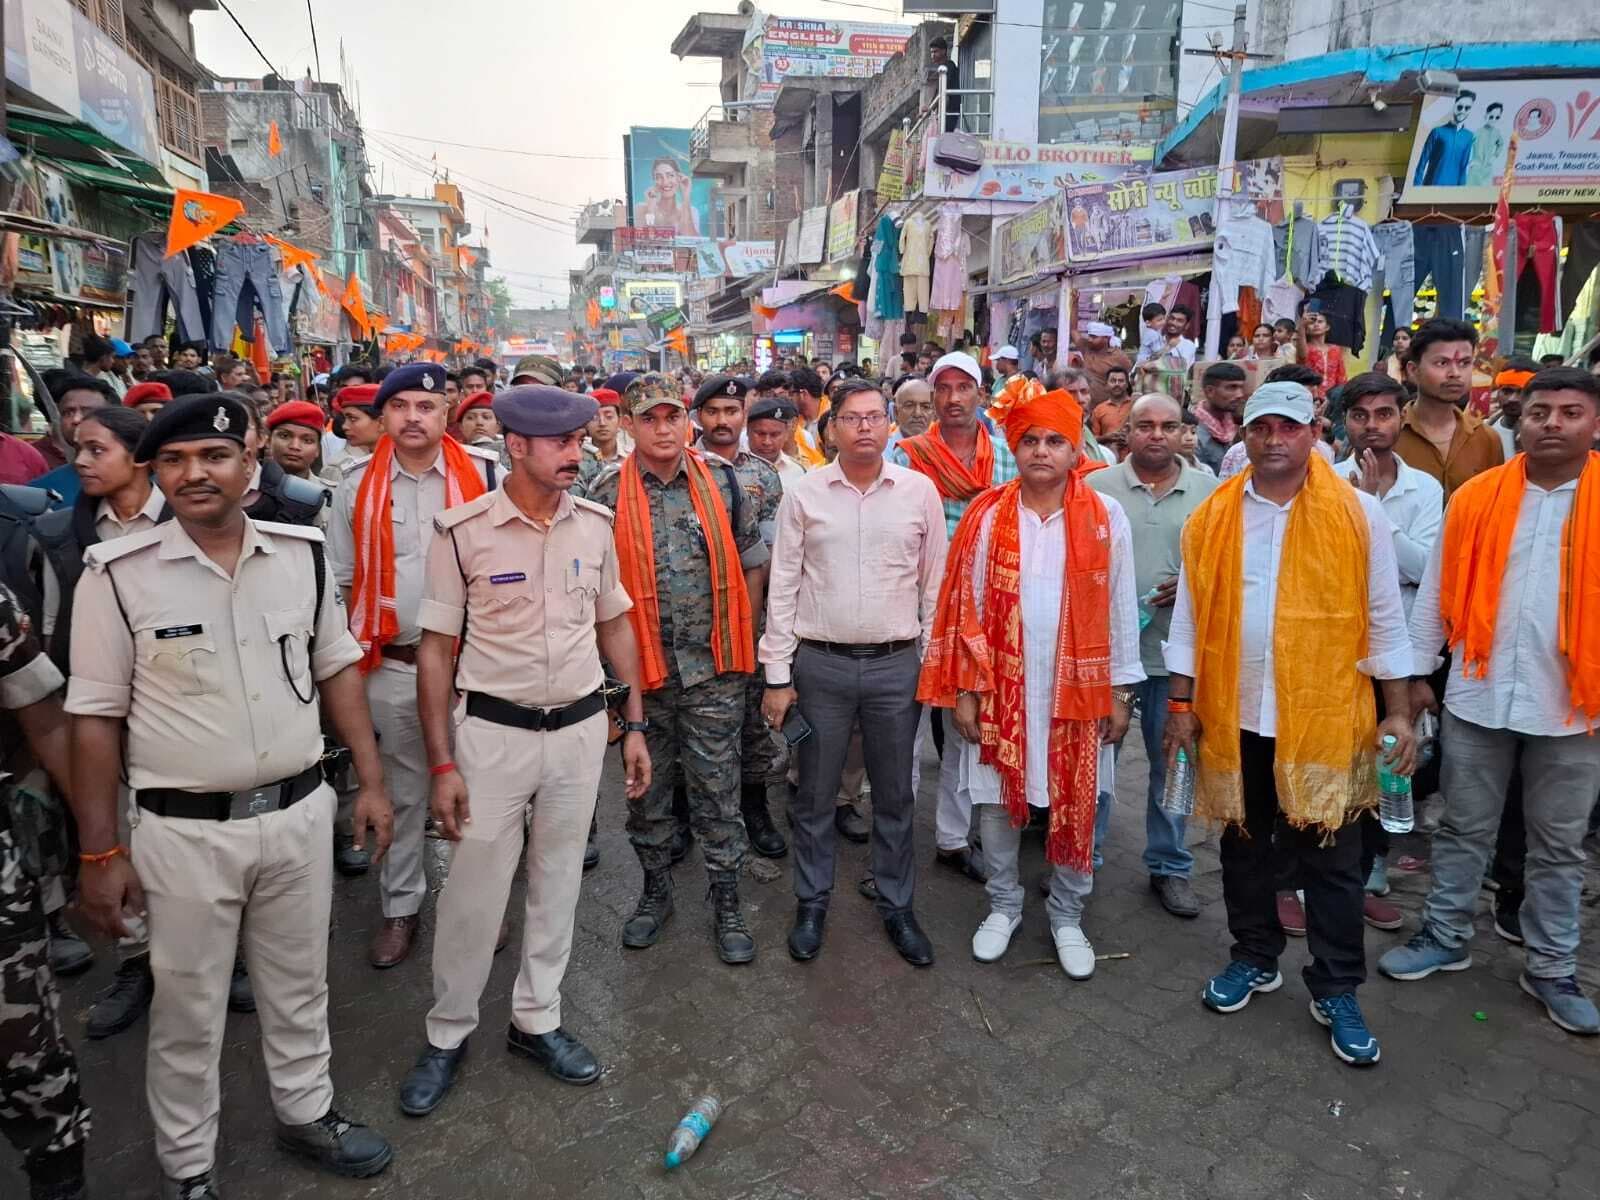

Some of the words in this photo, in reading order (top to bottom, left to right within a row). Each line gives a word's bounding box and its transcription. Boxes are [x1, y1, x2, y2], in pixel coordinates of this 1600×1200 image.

[768, 31, 837, 43] ENGLISH
[983, 147, 1030, 161] ELLO
[1038, 148, 1134, 164] BROTHER
[1152, 182, 1183, 211] न्यू
[1538, 189, 1570, 197] SORRY
[1574, 188, 1597, 196] NEW
